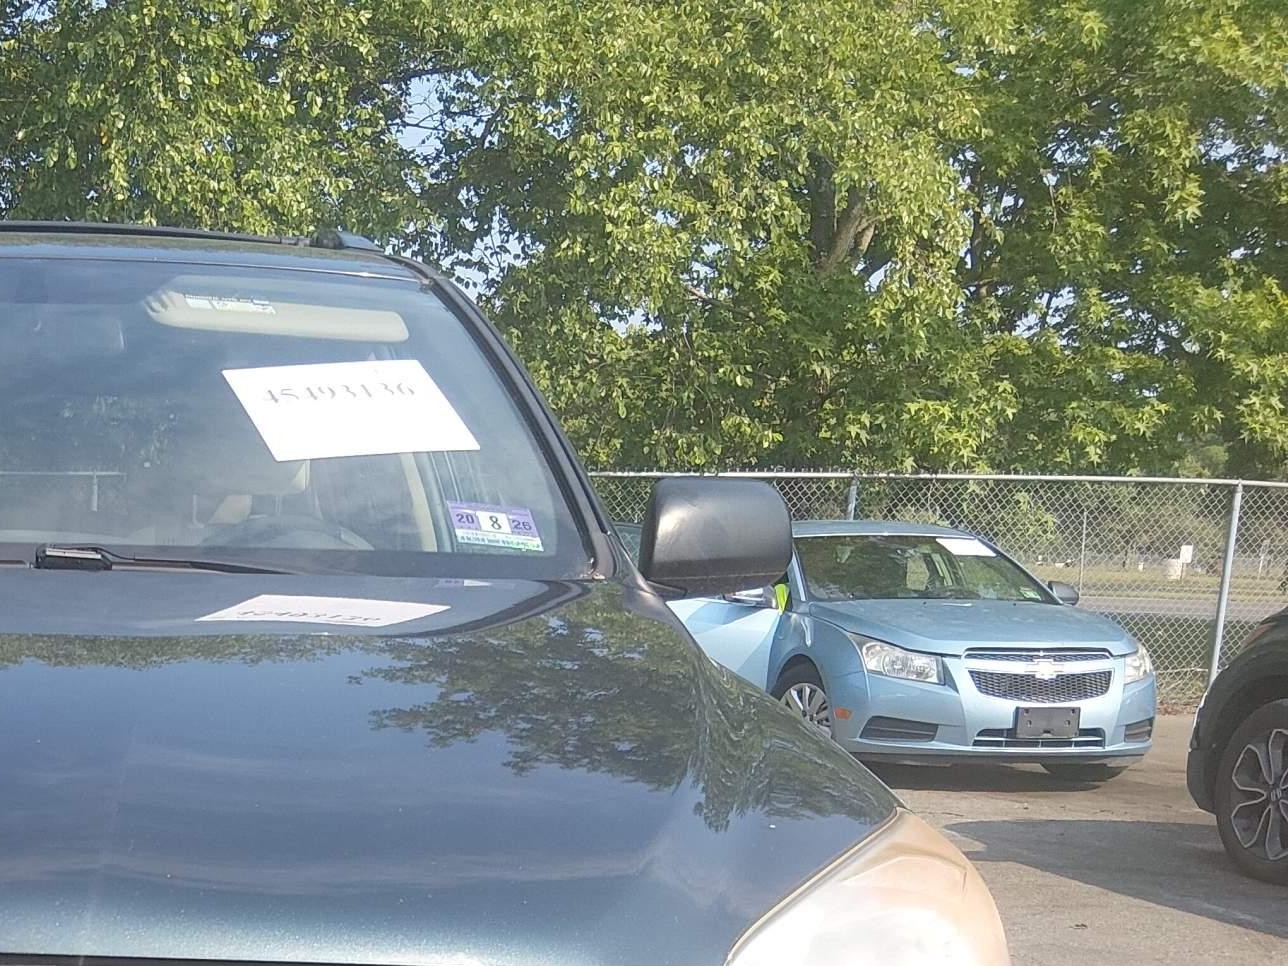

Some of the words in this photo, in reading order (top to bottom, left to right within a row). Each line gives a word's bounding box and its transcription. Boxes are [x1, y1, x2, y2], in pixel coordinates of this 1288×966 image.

[455, 512, 475, 524] 20
[489, 515, 502, 530] 8
[511, 519, 532, 531] 26
